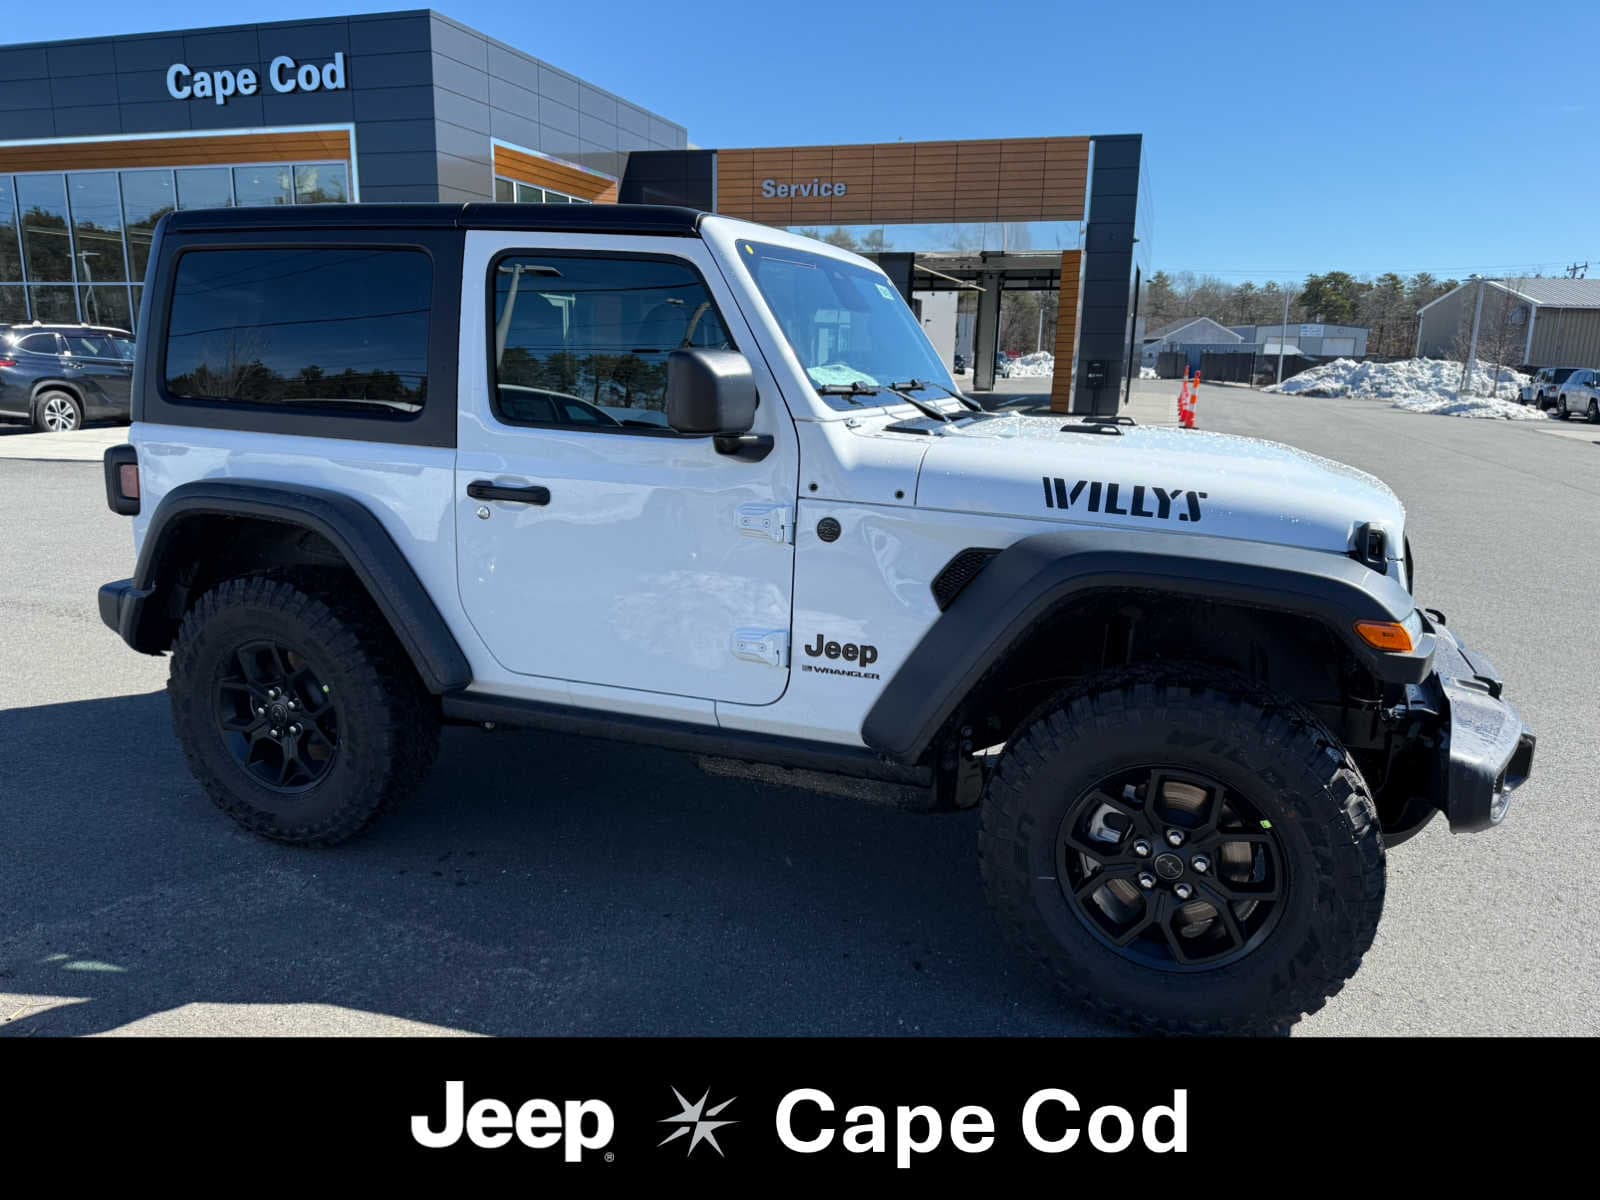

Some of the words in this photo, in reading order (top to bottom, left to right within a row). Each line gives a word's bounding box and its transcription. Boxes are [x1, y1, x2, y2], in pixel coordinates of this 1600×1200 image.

[166, 63, 258, 106] Cape
[269, 52, 347, 94] Cod
[762, 178, 847, 199] Service
[1042, 476, 1208, 523] WILLYS
[804, 633, 878, 668] Jeep
[813, 665, 880, 681] WRANGLER
